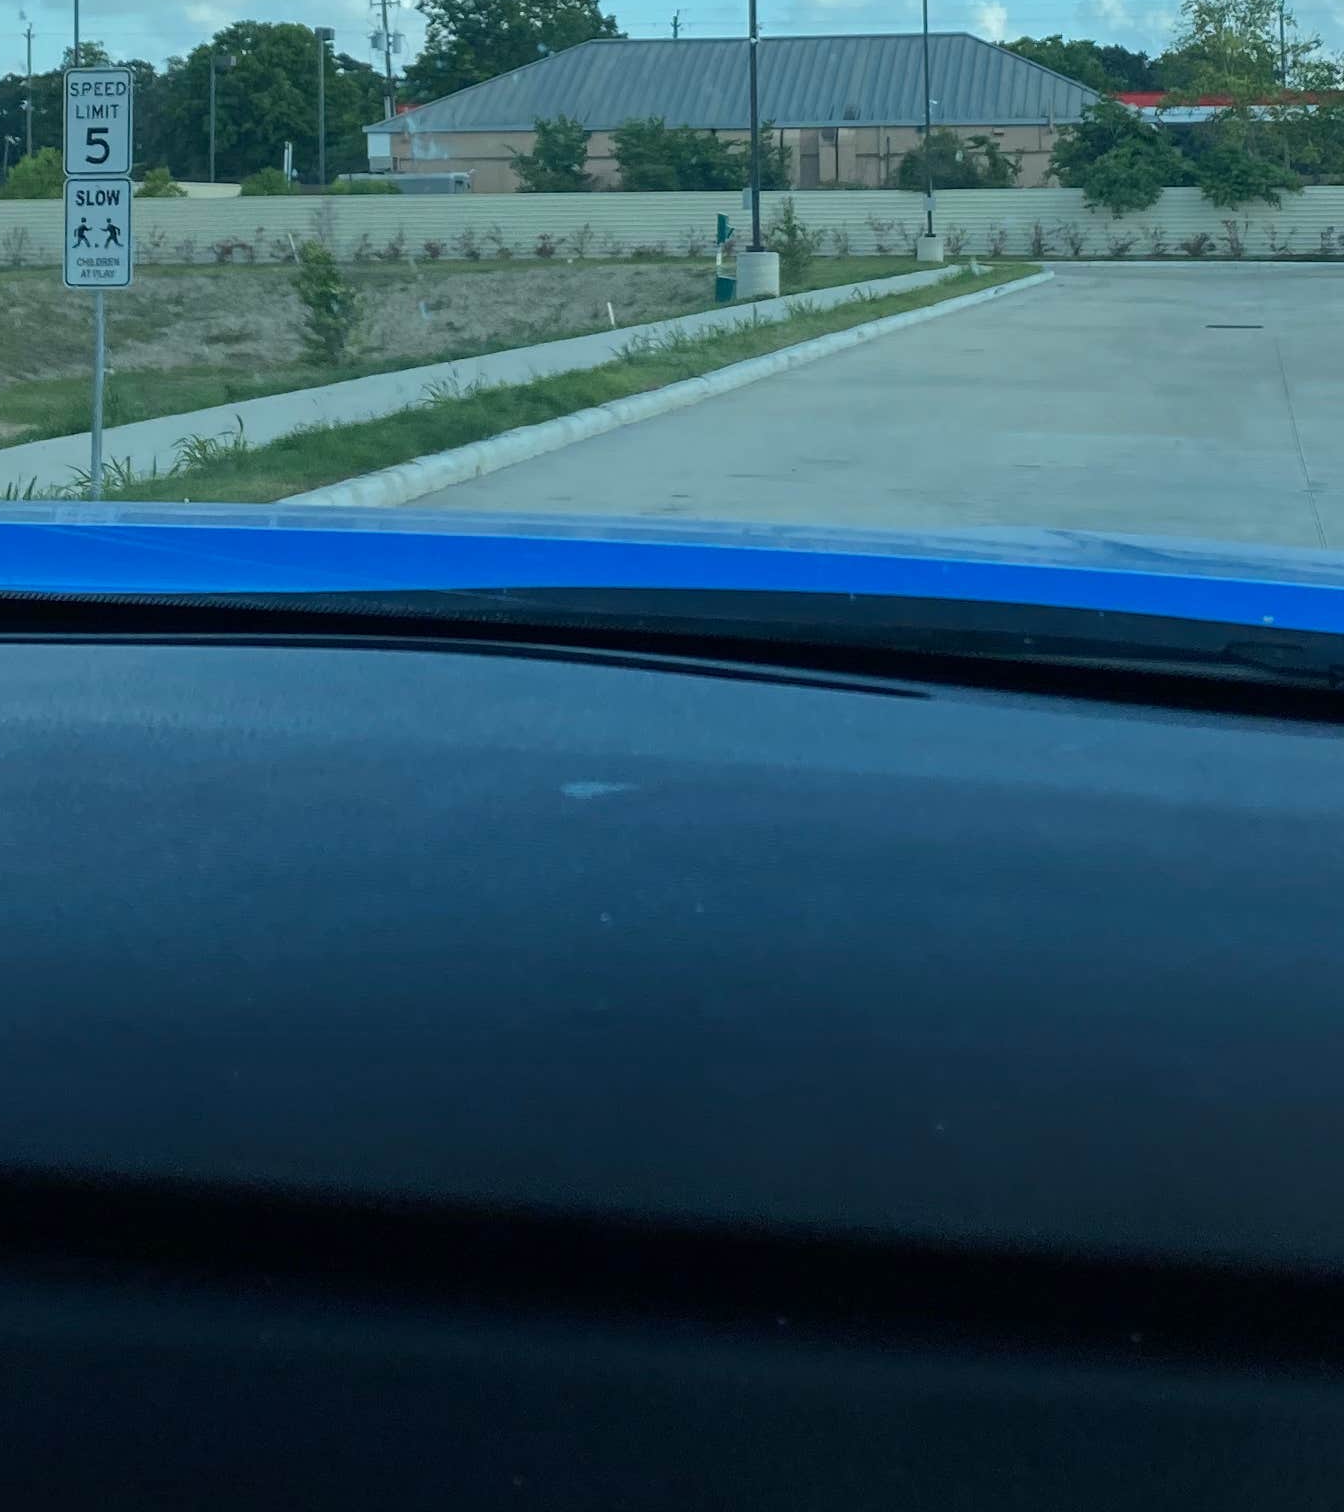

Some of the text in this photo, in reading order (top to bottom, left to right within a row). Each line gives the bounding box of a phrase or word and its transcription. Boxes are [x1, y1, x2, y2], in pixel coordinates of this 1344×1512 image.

[69, 82, 127, 97] SPEED
[75, 104, 120, 120] LIMIT
[85, 127, 111, 165] 5
[75, 190, 121, 207] SLOW
[76, 257, 121, 267] CHILDREN
[80, 269, 115, 279] AT PLAY
